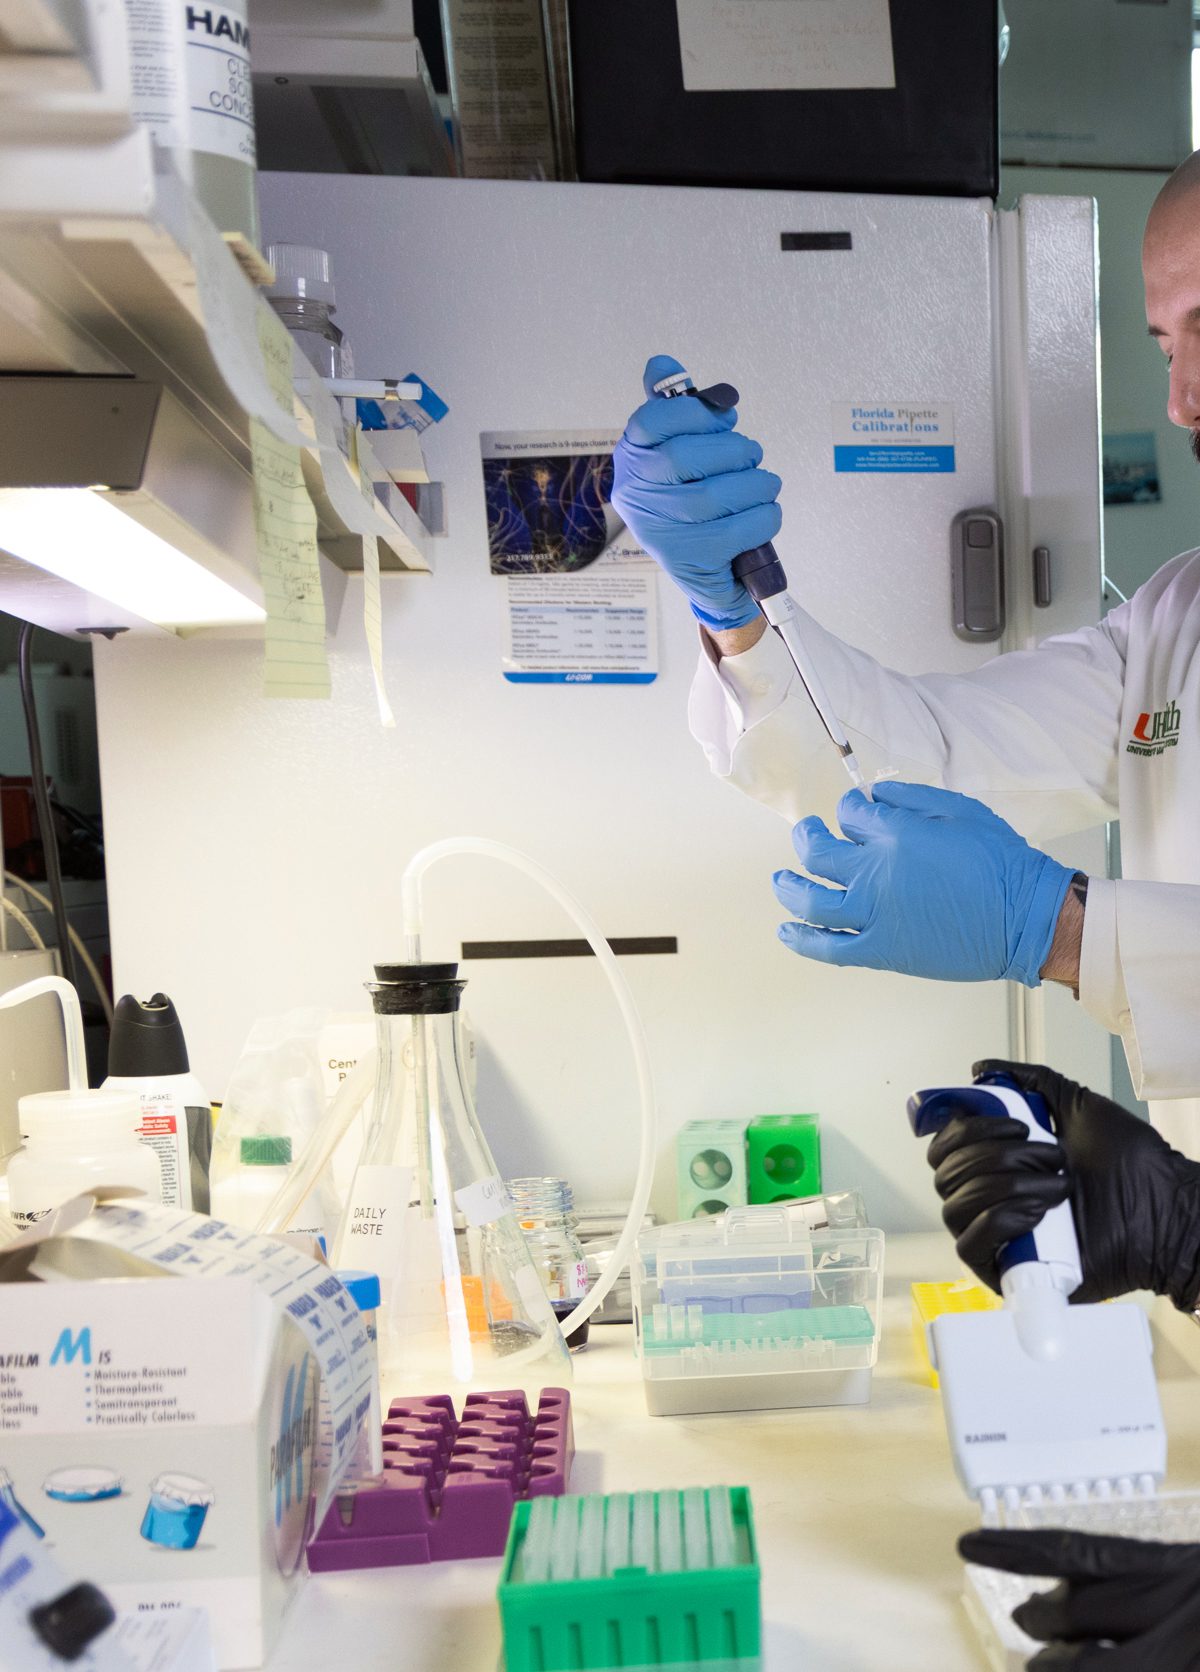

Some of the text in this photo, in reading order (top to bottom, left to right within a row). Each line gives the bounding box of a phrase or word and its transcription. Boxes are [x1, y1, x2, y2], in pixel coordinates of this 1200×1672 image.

[851, 408, 939, 421] Florida Pipette
[530, 441, 557, 449] research
[354, 1207, 386, 1219] DAILY
[351, 1224, 384, 1236] WASTE
[50, 1327, 91, 1366] M
[98, 1350, 111, 1365] IS
[95, 1382, 163, 1395] Thermoplastic
[95, 1398, 177, 1410] Semitransparent
[96, 1410, 195, 1425] Practically Colorless
